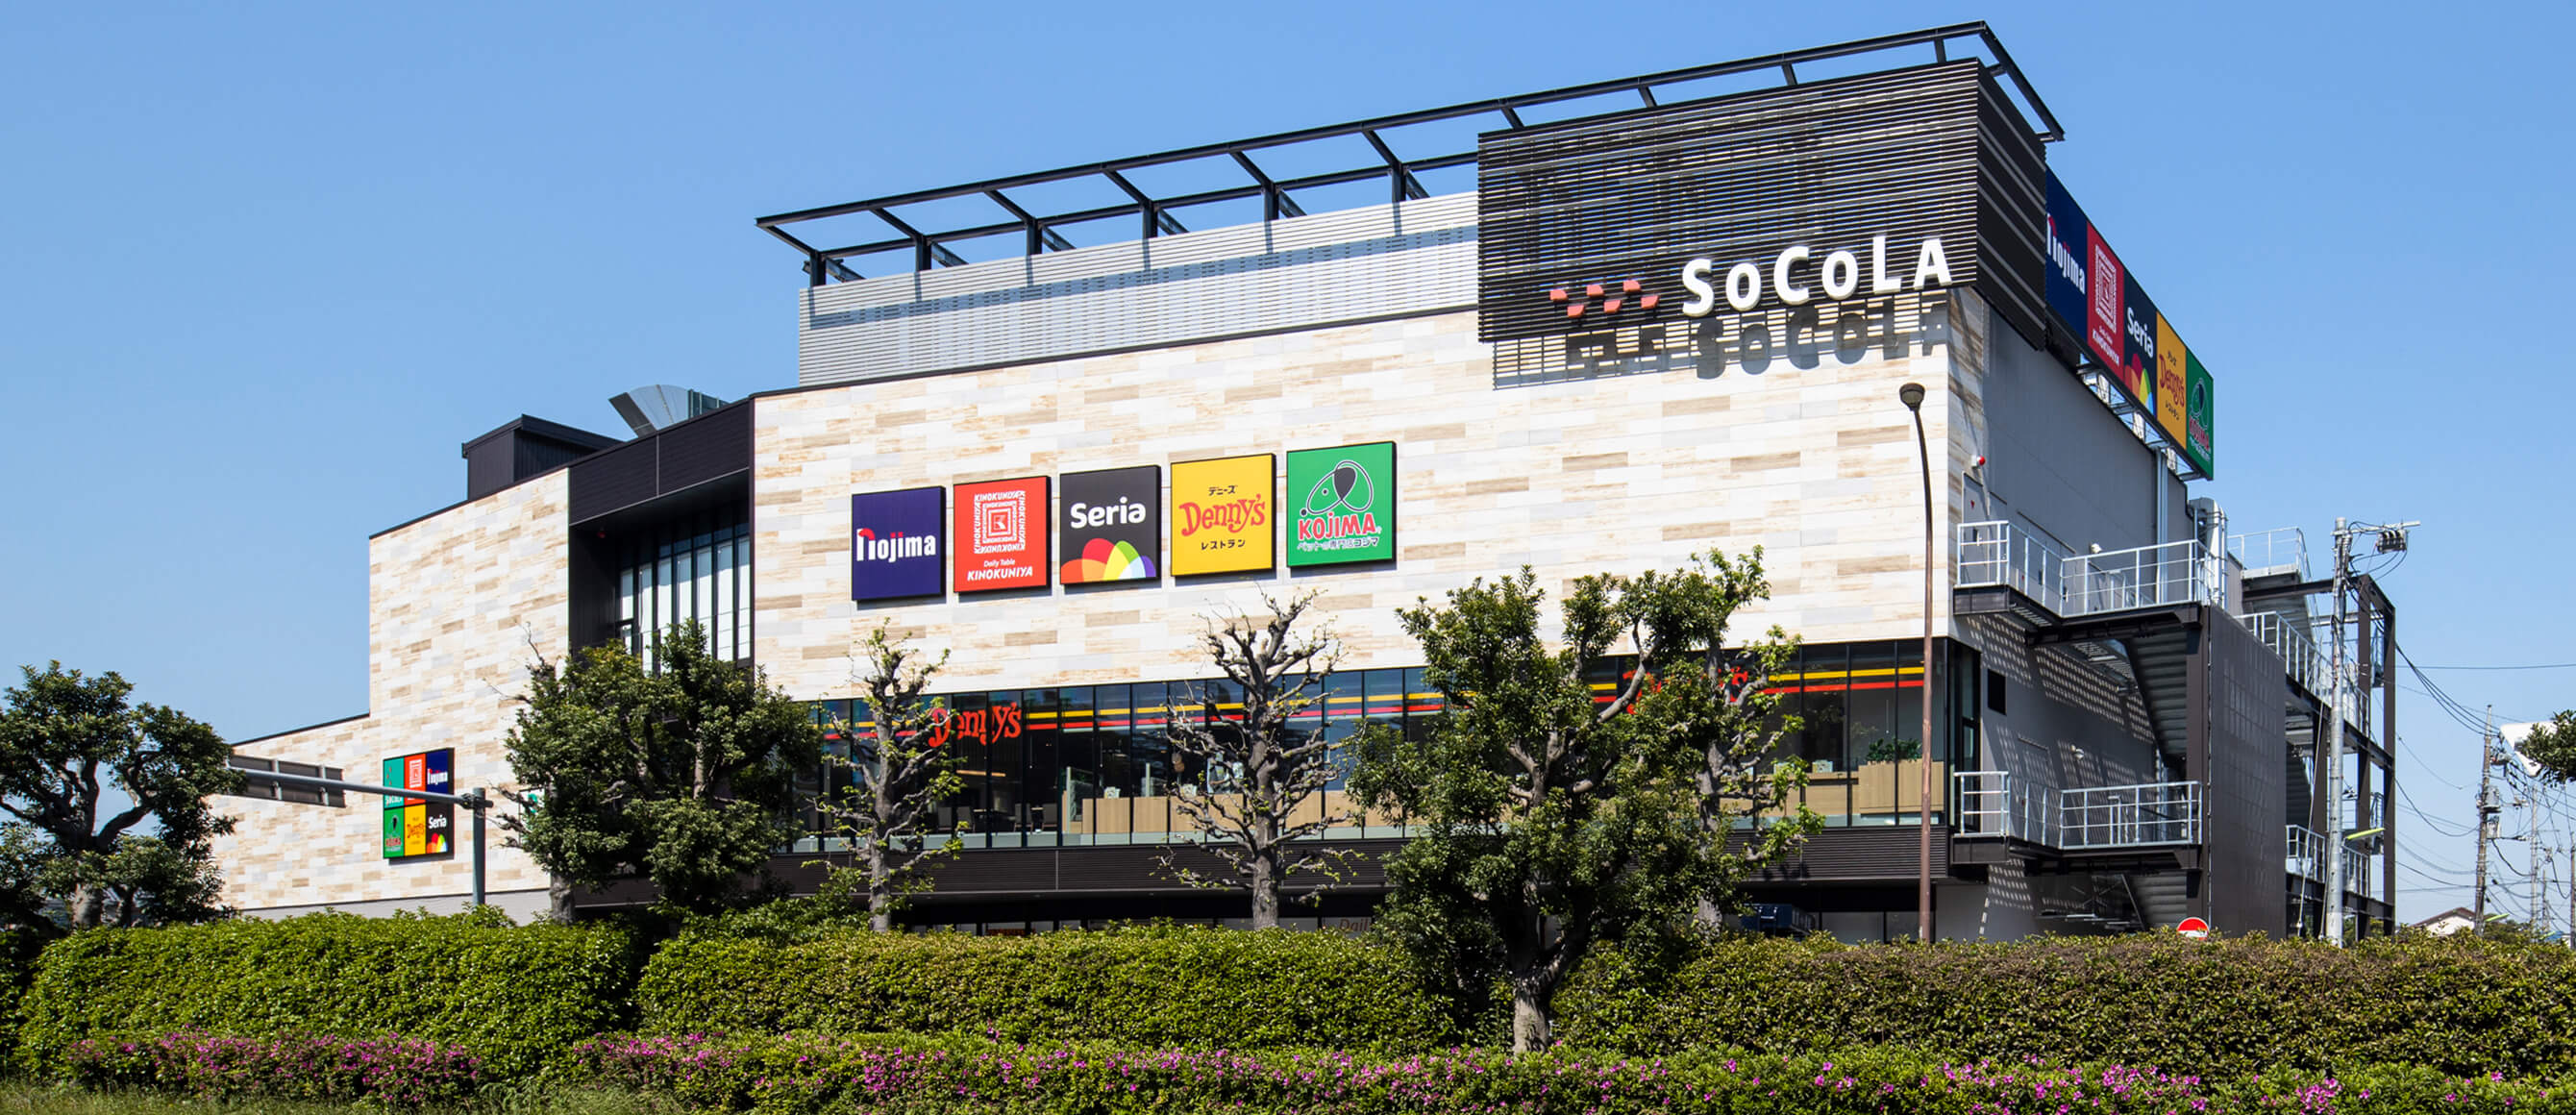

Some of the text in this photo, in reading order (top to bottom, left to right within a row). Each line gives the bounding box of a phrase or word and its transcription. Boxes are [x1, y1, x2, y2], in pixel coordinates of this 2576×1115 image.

[2126, 307, 2154, 359] Seria
[2159, 353, 2185, 408] Denny's
[1070, 495, 1147, 530] Seria
[1178, 493, 1266, 537] Denny's
[1201, 538, 1247, 551] レストラン
[967, 565, 1033, 582] KINOKUNIYA
[983, 558, 1016, 568] Daily Table
[429, 813, 447, 830] Seria
